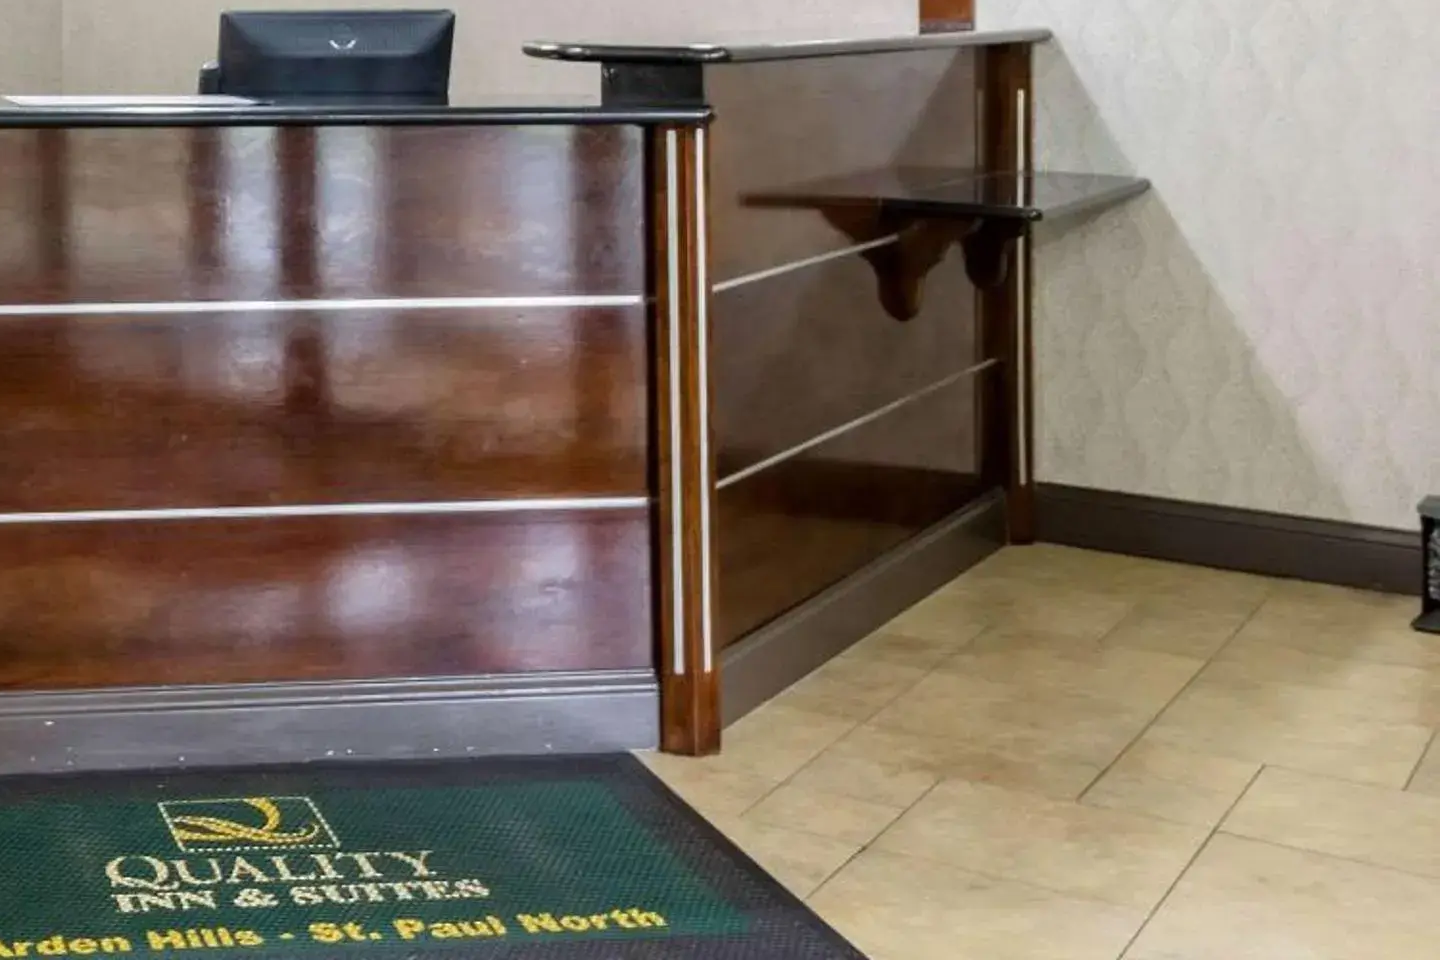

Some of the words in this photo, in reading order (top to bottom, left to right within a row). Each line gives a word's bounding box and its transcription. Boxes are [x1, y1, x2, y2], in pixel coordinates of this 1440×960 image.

[105, 851, 437, 890] QUALITY
[111, 890, 217, 913] INN
[233, 887, 279, 907] &
[289, 878, 490, 904] SUITES
[146, 927, 264, 951] Hills
[309, 921, 382, 941] St.
[393, 915, 506, 939] Paul
[516, 907, 667, 933] North
